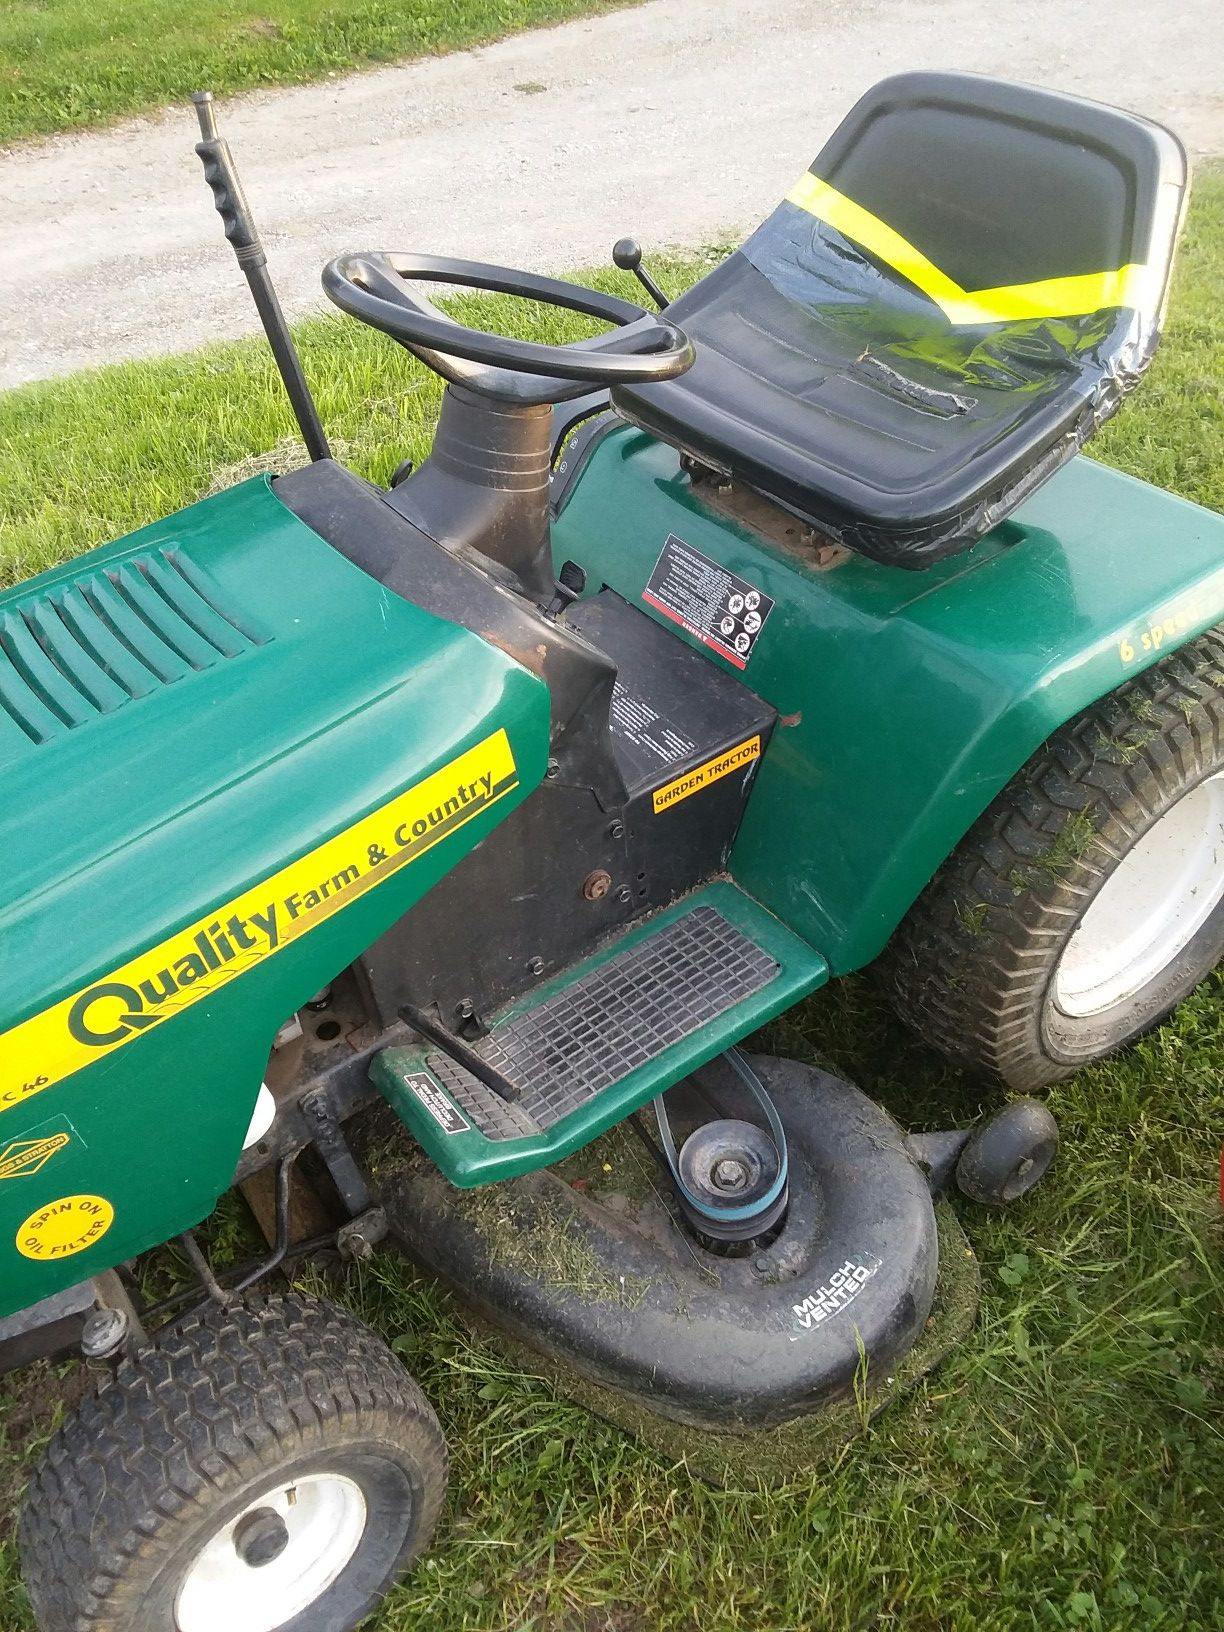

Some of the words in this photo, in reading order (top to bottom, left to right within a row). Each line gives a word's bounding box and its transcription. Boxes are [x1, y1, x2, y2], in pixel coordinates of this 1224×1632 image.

[1120, 639, 1134, 662] 6
[655, 773, 704, 806] GARDEN
[707, 742, 759, 779] TRACTOR
[68, 904, 280, 1046] Quality
[285, 863, 360, 920] Farm
[367, 843, 388, 866] &
[394, 771, 494, 846] Country
[22, 1136, 65, 1161] STRATTON
[25, 1237, 43, 1254] OIL
[50, 1220, 105, 1255] FILTER
[30, 1202, 72, 1230] SPIN
[79, 1201, 103, 1216] ON
[792, 1260, 857, 1317] MULCH
[797, 1265, 871, 1328] VENTED
